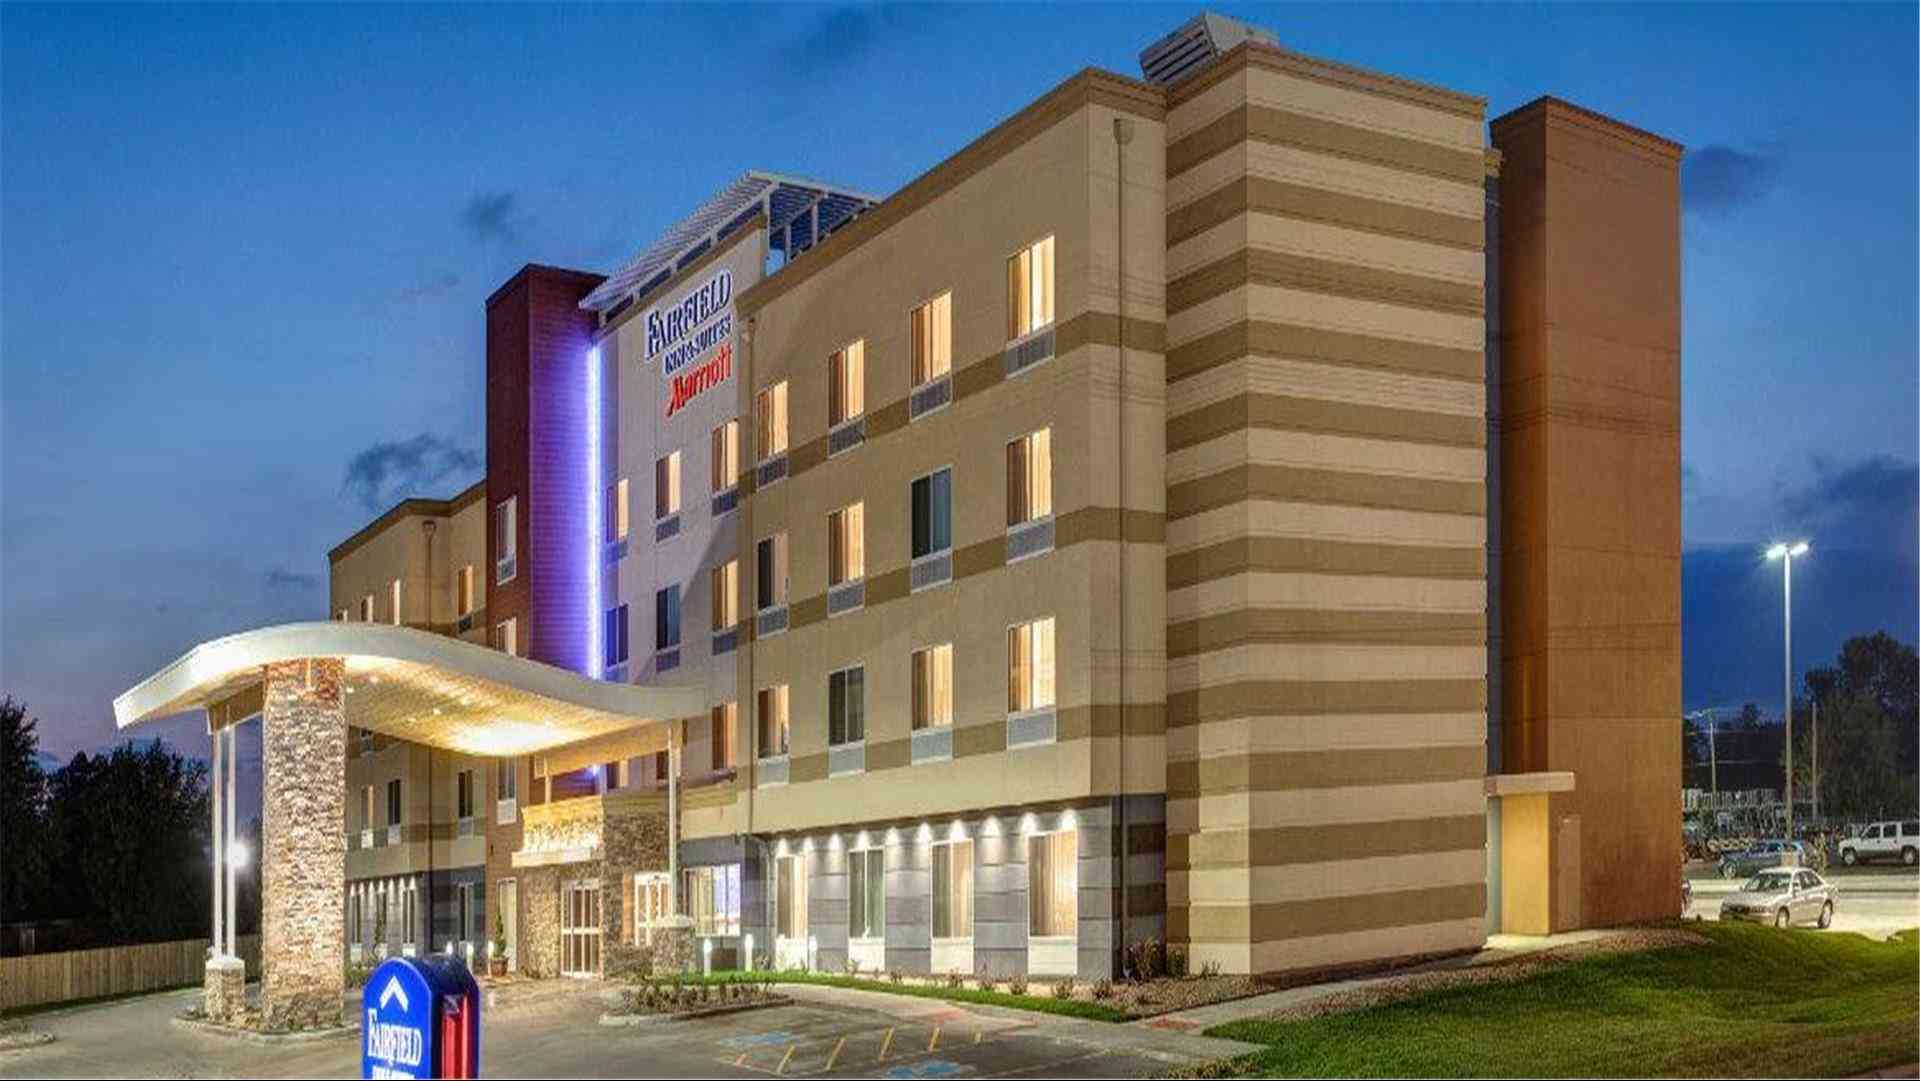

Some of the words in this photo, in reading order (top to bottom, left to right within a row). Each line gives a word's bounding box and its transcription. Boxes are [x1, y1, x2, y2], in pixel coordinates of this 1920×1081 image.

[645, 270, 732, 361] FAIRFIELD
[667, 342, 732, 417] Marriott
[367, 1007, 422, 1067] FAIRFIELD
